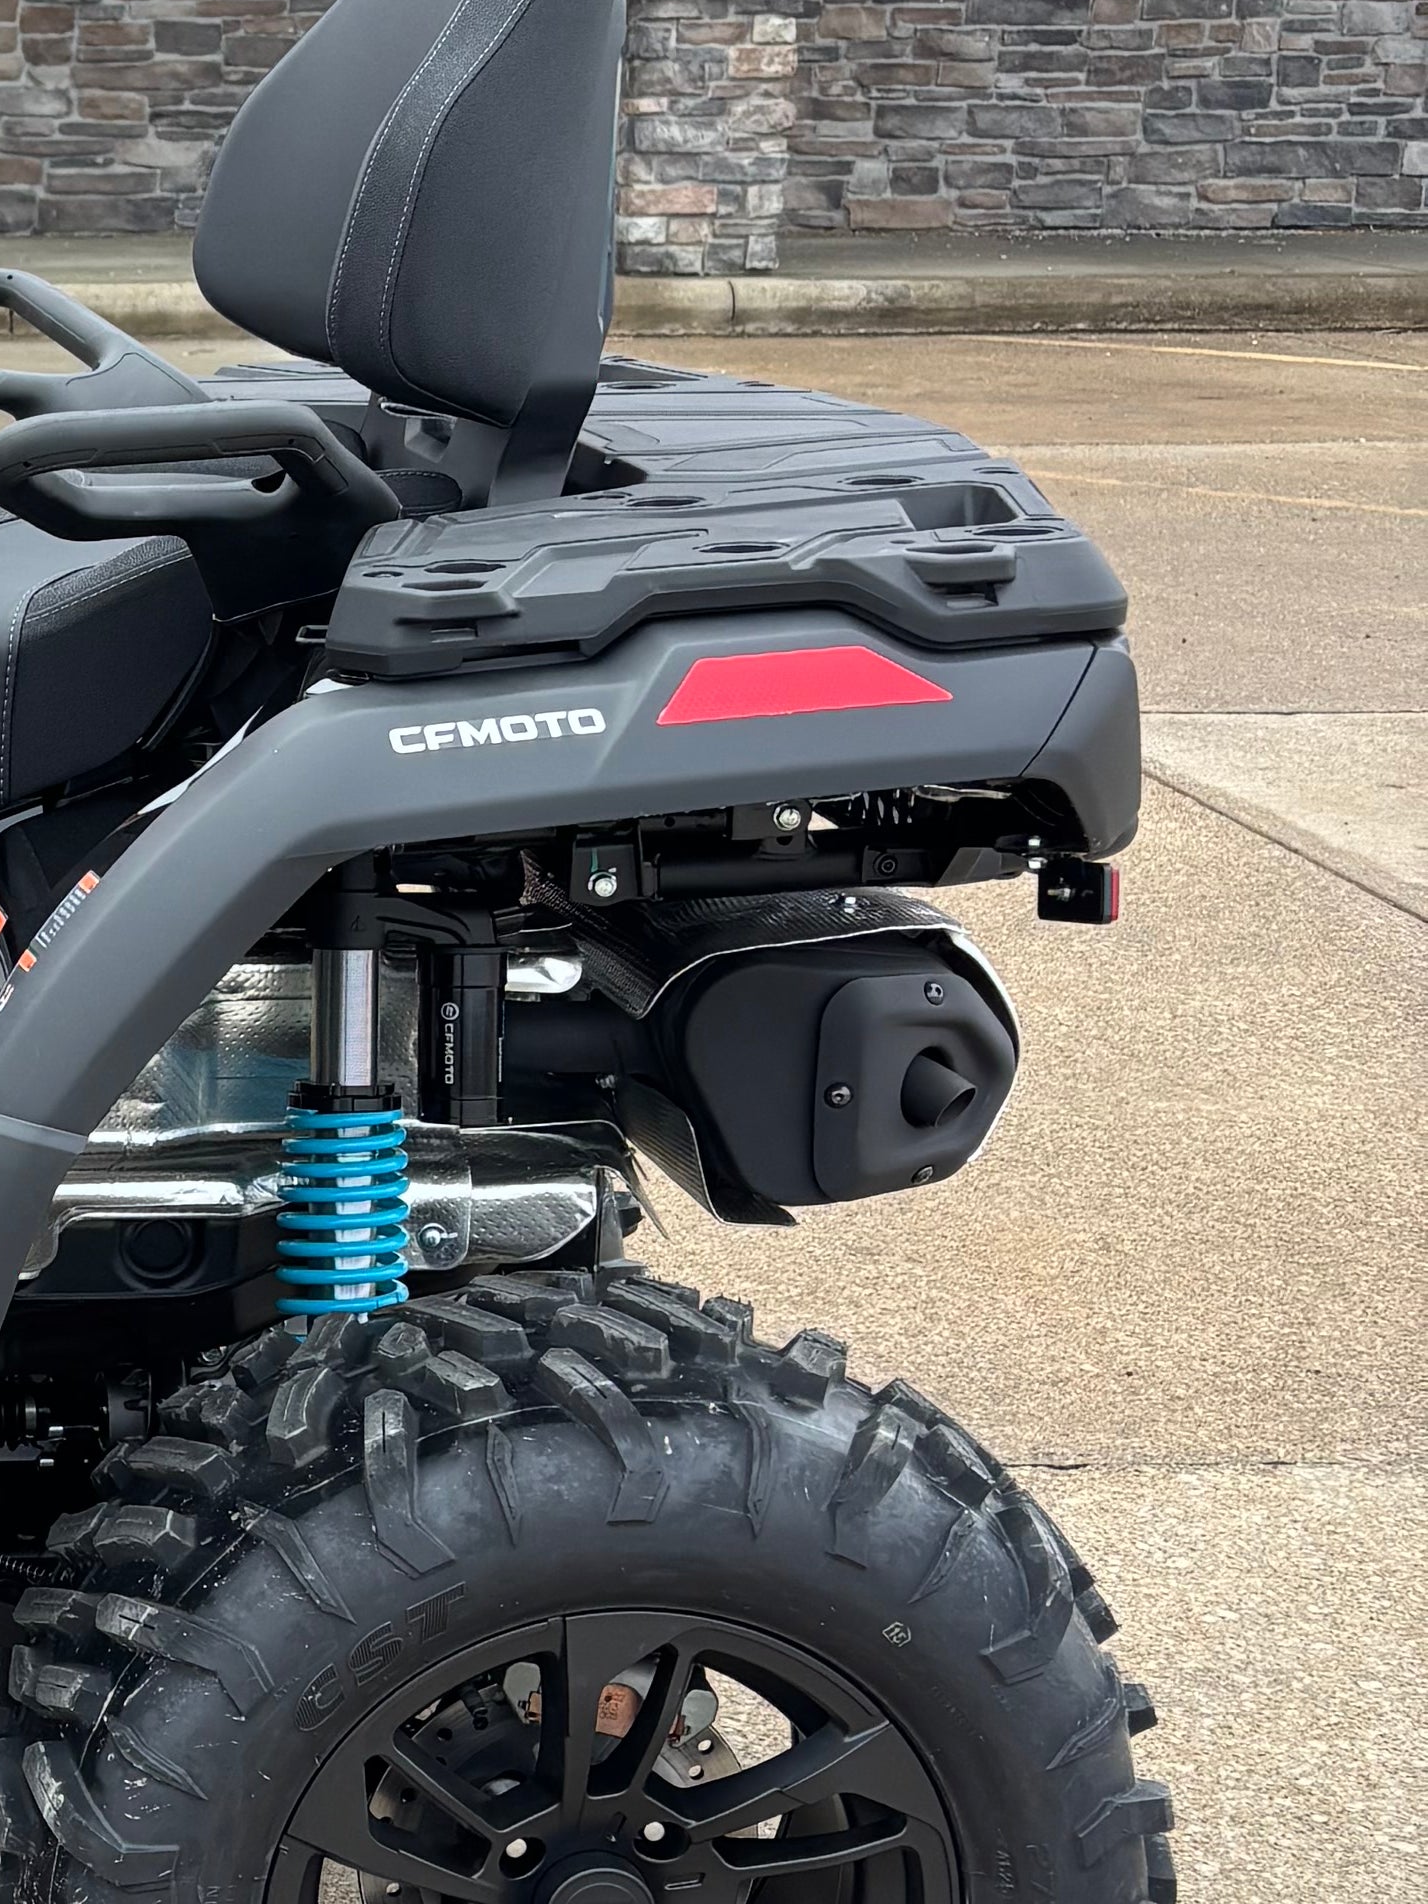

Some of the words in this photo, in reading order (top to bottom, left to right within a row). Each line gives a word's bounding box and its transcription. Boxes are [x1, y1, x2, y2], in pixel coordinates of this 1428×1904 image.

[389, 708, 607, 754] CFMOTO
[445, 1023, 455, 1084] CFMOTO
[295, 1581, 466, 1732] CST
